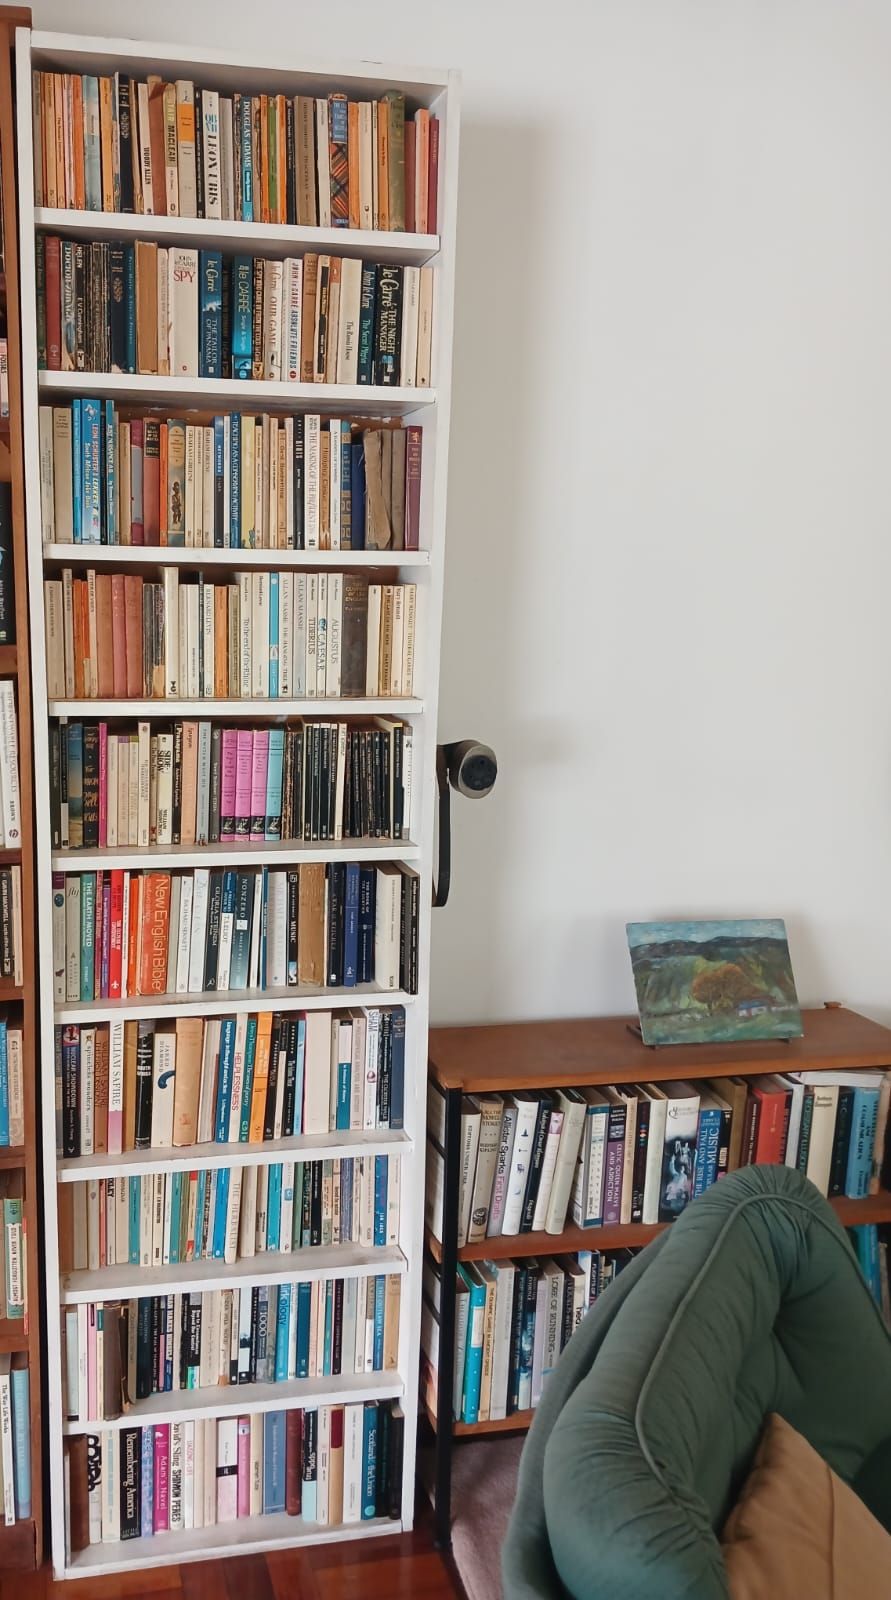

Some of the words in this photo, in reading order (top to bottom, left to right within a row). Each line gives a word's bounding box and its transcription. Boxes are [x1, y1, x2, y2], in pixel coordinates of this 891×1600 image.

[243, 101, 251, 138] DOUGLAS
[143, 147, 151, 168] WOODY
[167, 125, 176, 162] MACLEAN
[207, 134, 217, 170] LEON
[208, 173, 218, 205] URIS
[173, 270, 196, 282] SPY
[208, 260, 218, 268] le
[363, 270, 375, 286] John
[382, 268, 398, 278] le
[206, 268, 219, 292] Carré
[379, 278, 400, 307] Carré
[238, 281, 251, 313] CARRÉ
[379, 310, 388, 351] MANAGER
[387, 308, 397, 326] THE
[386, 327, 396, 354] NIGHT
[317, 633, 326, 671] CAESAR
[330, 618, 339, 664] AUGUSTUS
[155, 879, 168, 909] New
[152, 910, 168, 956] English
[152, 958, 165, 990] Bible
[368, 1011, 378, 1032] SHAM
[112, 1023, 121, 1068] WILLIAM
[112, 1071, 121, 1105] SAFIRE
[232, 1052, 242, 1111] HELPLESSNESS
[502, 1115, 512, 1144] Allister
[498, 1145, 509, 1174] Sparks
[707, 1128, 719, 1163] MUSIC
[496, 1176, 505, 1194] First
[607, 1166, 615, 1202] ADDICTION
[492, 1195, 503, 1220] Drafts
[551, 1277, 559, 1298] LORE
[550, 1300, 558, 1311] OF
[259, 1311, 267, 1337] 1000
[548, 1312, 558, 1353] RUNNING
[172, 1447, 181, 1466] Sling
[368, 1429, 376, 1459] Scotland
[122, 1433, 137, 1486] Remembering
[172, 1469, 181, 1498] SHIMON
[126, 1487, 136, 1518] America
[172, 1500, 180, 1522] PERES
